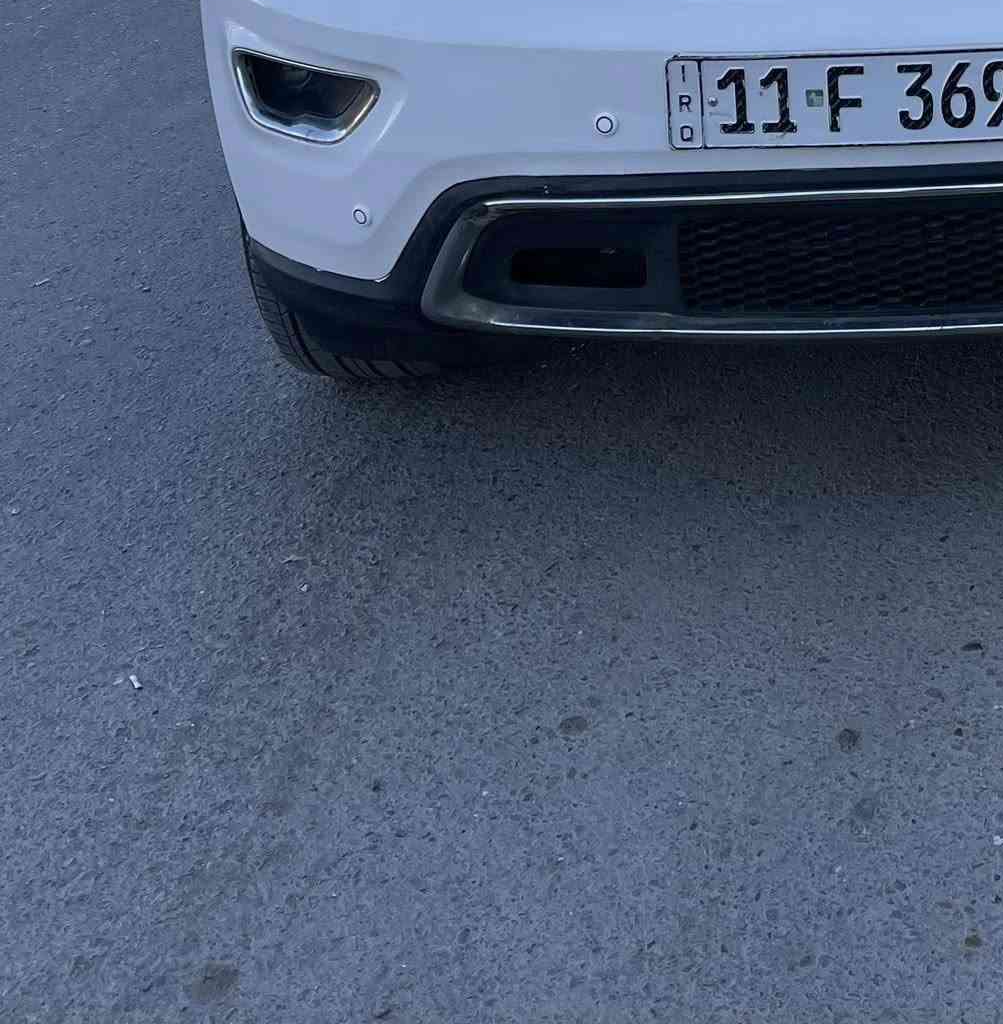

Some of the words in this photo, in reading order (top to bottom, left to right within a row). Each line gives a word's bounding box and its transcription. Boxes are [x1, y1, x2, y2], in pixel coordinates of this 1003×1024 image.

[677, 64, 695, 143] IRQ
[716, 66, 798, 134] 11
[826, 65, 865, 133] F
